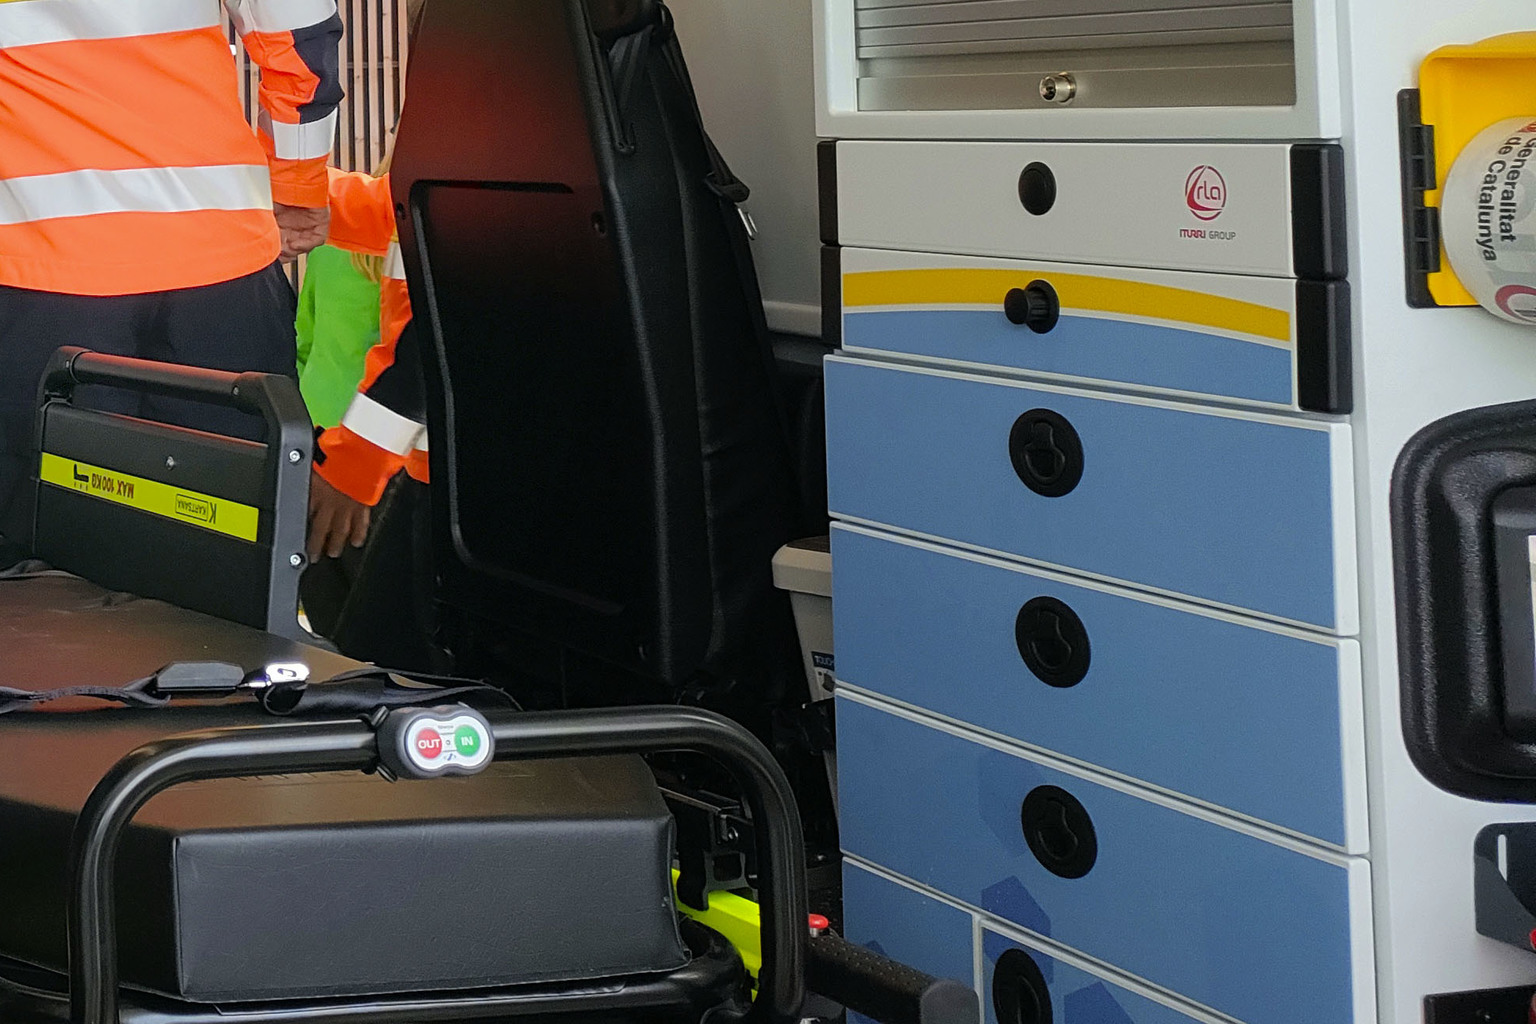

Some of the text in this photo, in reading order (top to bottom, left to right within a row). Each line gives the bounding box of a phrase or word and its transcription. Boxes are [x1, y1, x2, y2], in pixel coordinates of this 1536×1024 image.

[1196, 179, 1222, 201] rla
[1475, 136, 1522, 262] de Catalunya
[1498, 137, 1536, 243] Generalitat
[1208, 230, 1237, 241] GROUP
[116, 479, 134, 499] MAX
[418, 735, 473, 749] OUT IN
